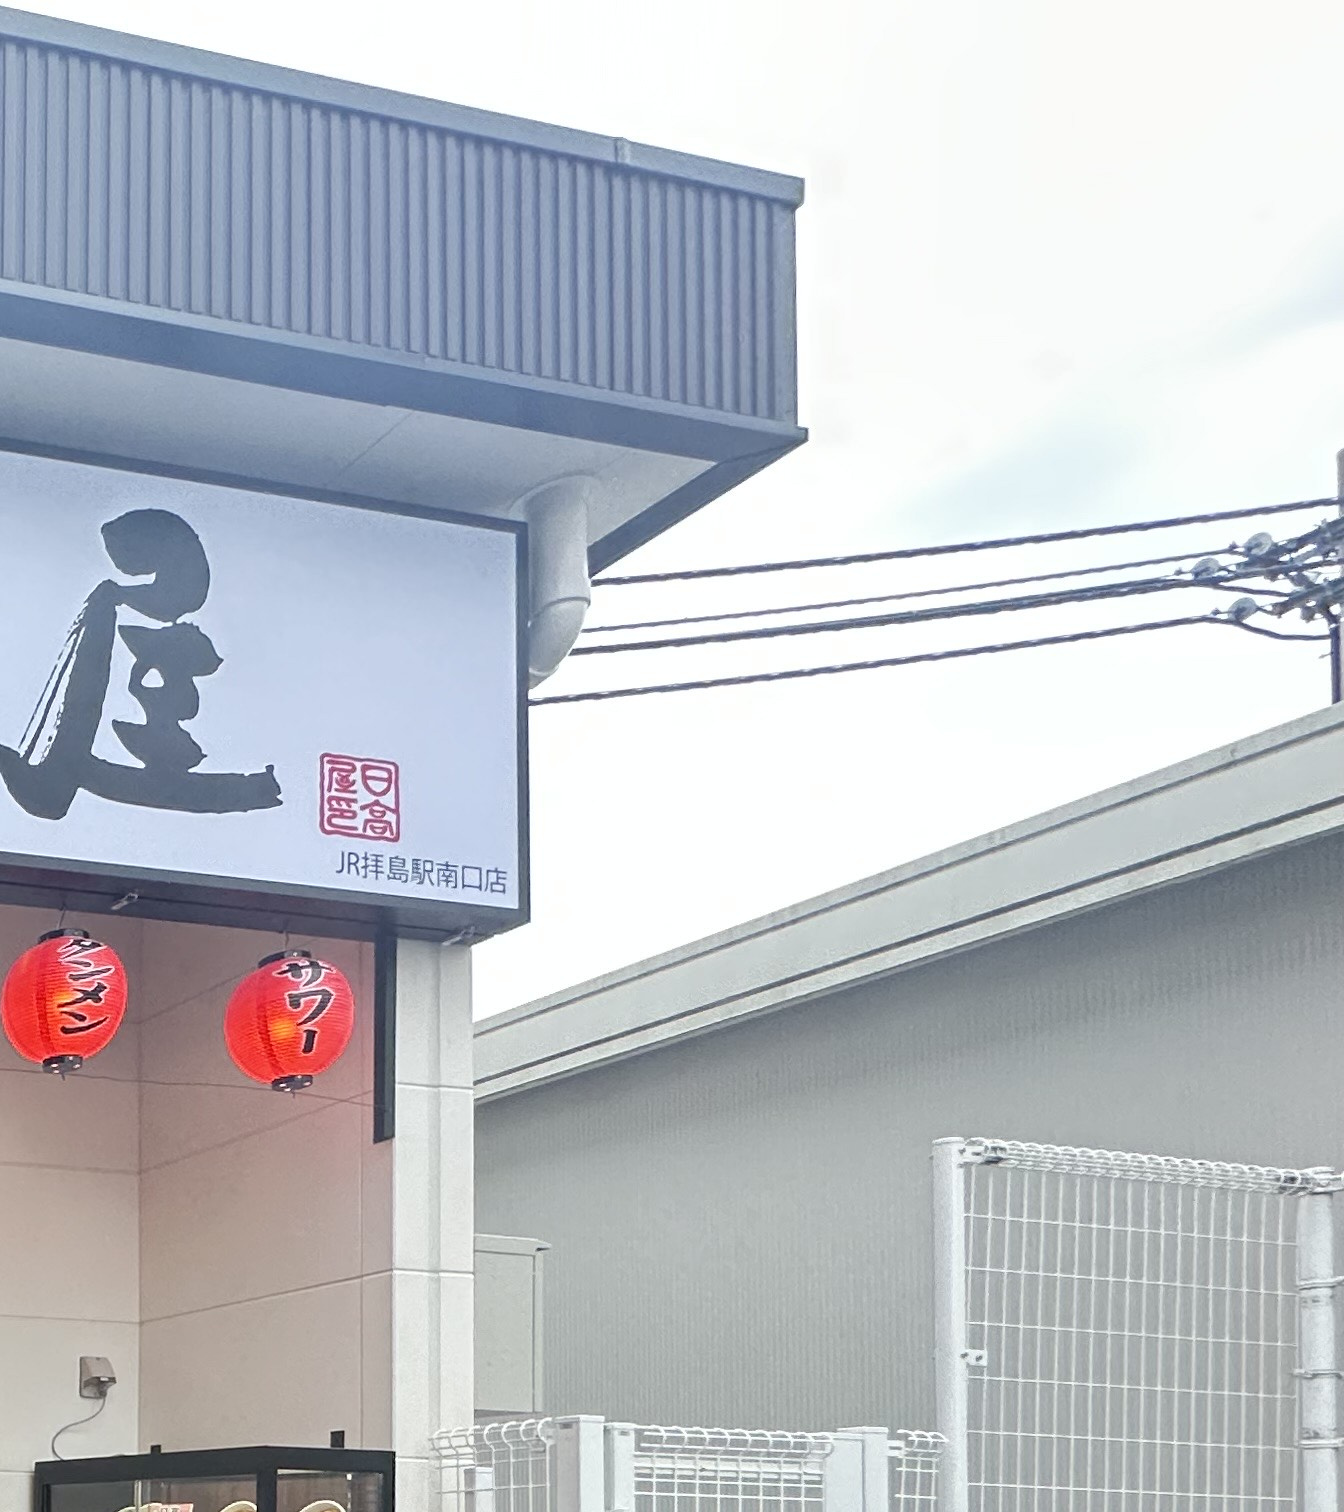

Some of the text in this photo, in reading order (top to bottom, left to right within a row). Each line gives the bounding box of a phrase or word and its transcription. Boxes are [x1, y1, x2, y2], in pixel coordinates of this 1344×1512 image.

[336, 851, 508, 894] JR拝島駅南口店
[276, 961, 334, 1054] サワー
